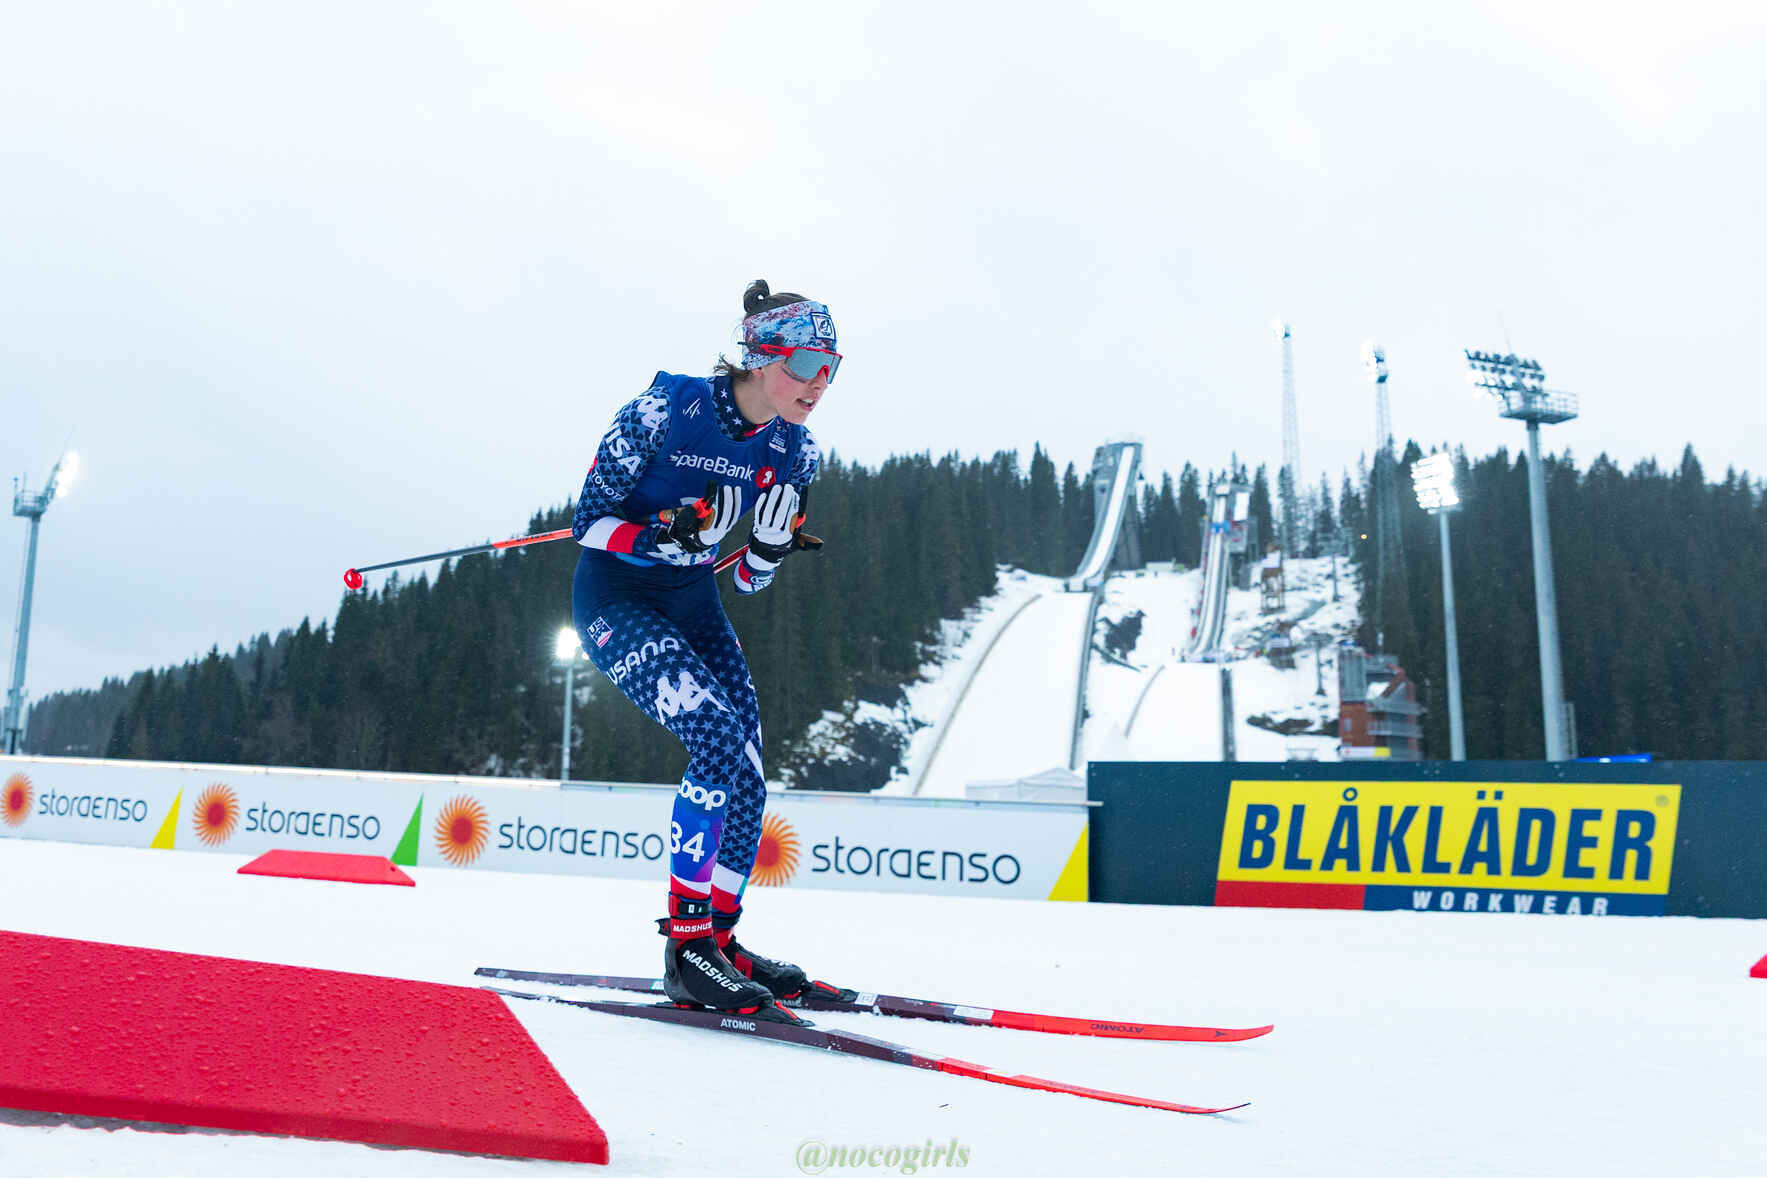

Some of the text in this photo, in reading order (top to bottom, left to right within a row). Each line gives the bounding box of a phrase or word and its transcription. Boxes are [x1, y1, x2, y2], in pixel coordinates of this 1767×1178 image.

[606, 637, 681, 686] USANA
[39, 787, 148, 822] storaenso
[680, 776, 727, 811] oop
[246, 801, 381, 840] storaenso
[498, 816, 664, 862] storaenso
[1237, 786, 1658, 882] BLÅKLÄDER
[812, 836, 1021, 885] storaenso
[1412, 890, 1609, 917] WORKWEAR
[672, 921, 713, 934] MADSHUS
[682, 949, 744, 993] MADSHUS
[720, 1018, 757, 1032] ATOMIC
